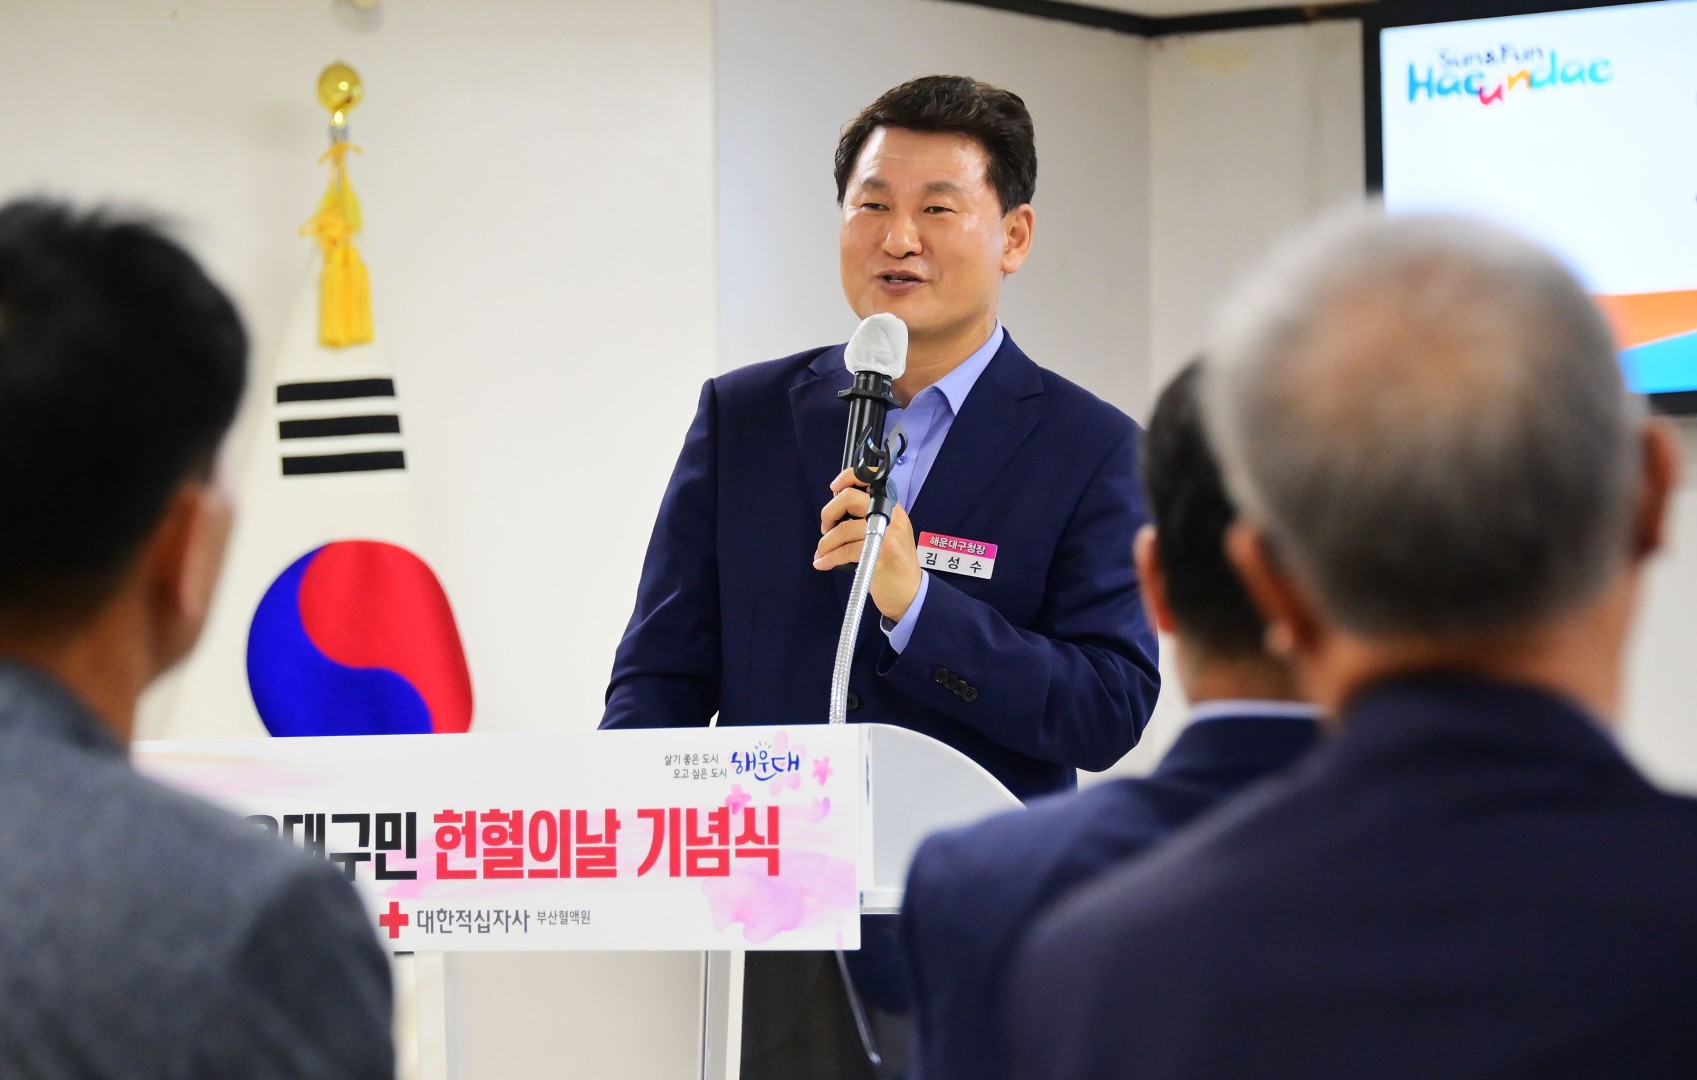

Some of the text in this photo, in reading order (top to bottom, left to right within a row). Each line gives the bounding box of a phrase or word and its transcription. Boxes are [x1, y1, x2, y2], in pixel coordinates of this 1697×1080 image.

[929, 535, 987, 556] 해운대구청장
[664, 753, 719, 766] 살기 좋은 도시
[731, 750, 800, 781] 해운대
[672, 768, 727, 780] 오고 싶은 도시
[433, 809, 621, 880] 헌혈의날
[637, 806, 780, 878] 기념식
[416, 907, 591, 934] 대한적십자사 부산혈액원
